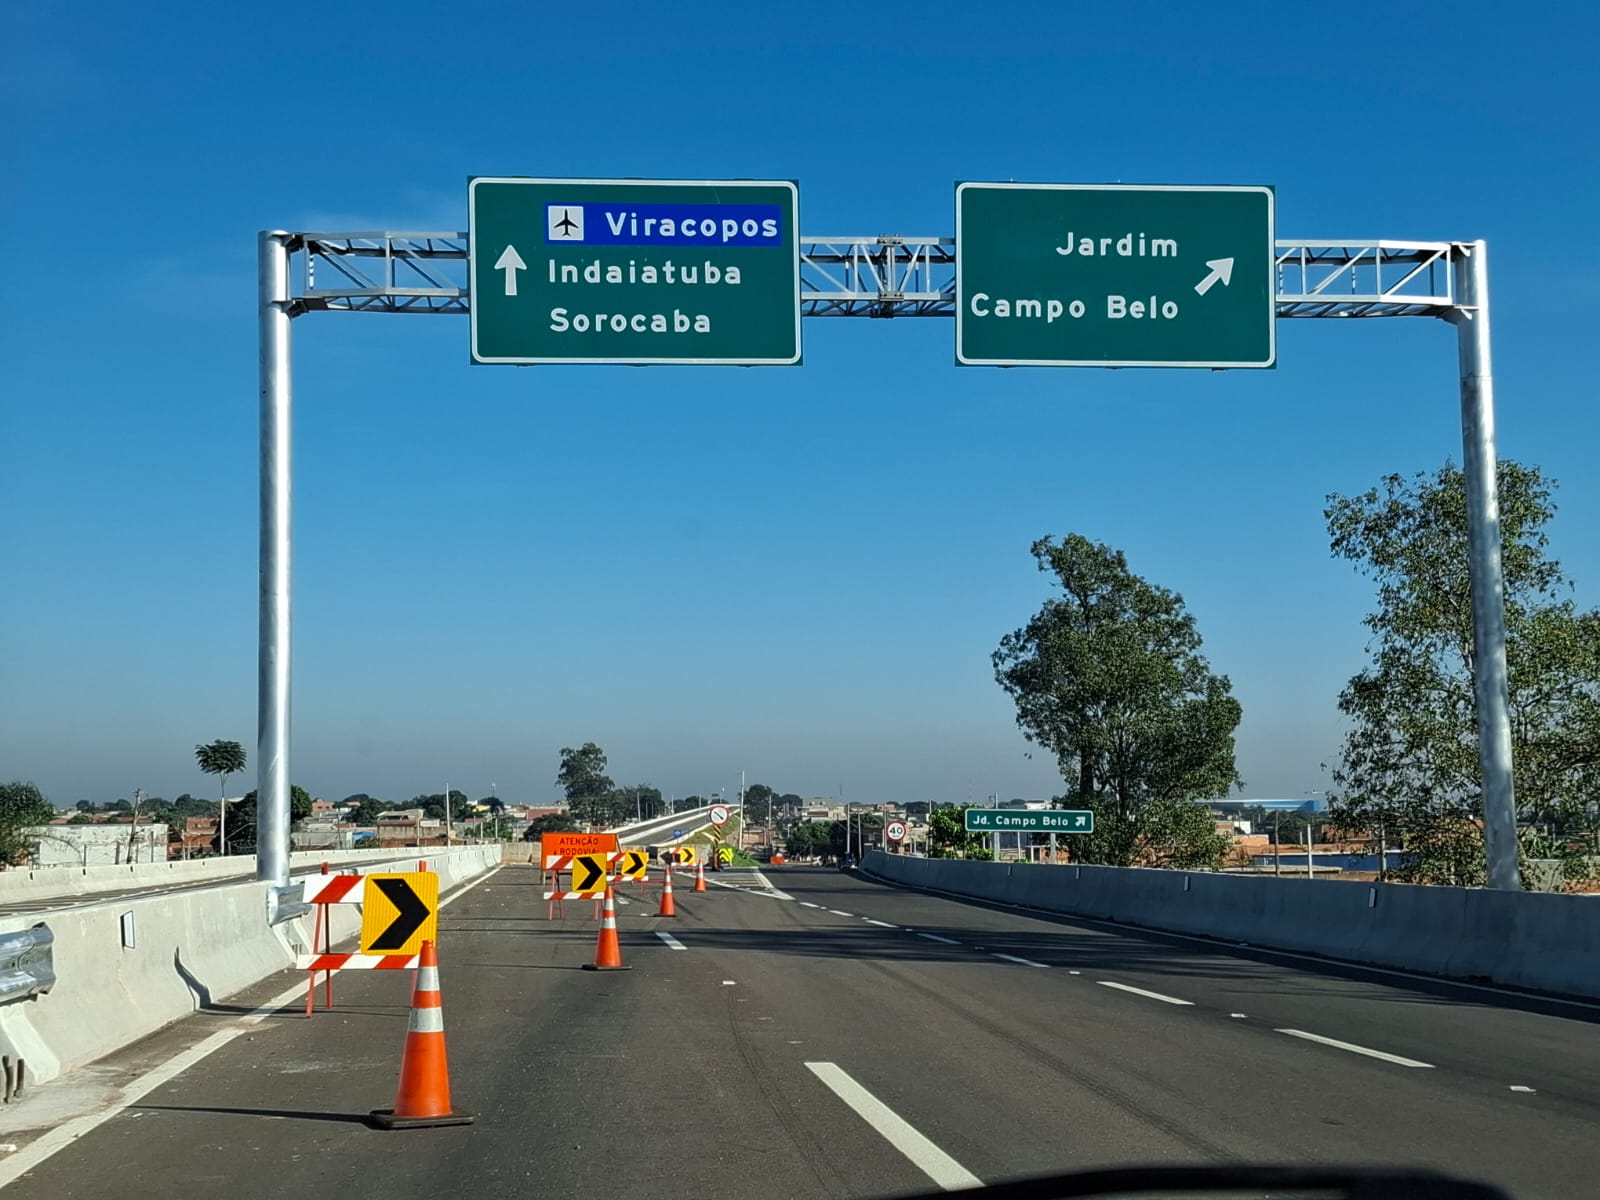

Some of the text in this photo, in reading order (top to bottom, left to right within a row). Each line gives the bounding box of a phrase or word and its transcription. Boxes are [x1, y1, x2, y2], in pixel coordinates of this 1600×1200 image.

[605, 212, 778, 242] Viracopos
[1056, 232, 1178, 257] Jardim
[549, 259, 742, 284] Indaiatuba
[549, 307, 711, 333] Sorocaba
[970, 293, 1179, 323] Campo Belo
[889, 827, 903, 835] 40
[973, 816, 1069, 827] Jd. Campo Belo
[560, 835, 598, 846] ATENÇÃO
